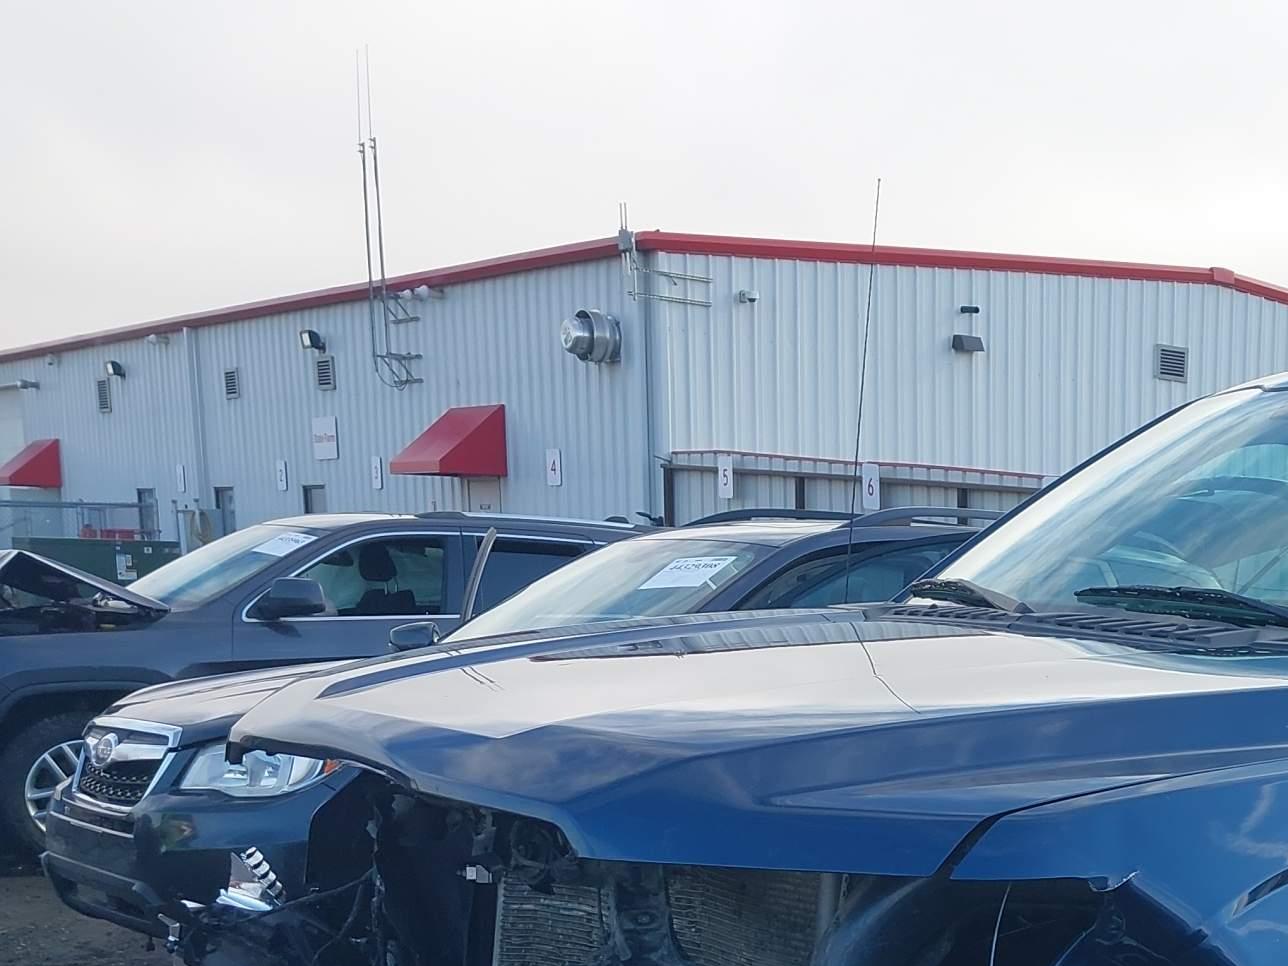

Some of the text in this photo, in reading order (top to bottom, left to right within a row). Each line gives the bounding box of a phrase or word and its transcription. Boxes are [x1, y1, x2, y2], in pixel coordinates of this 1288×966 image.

[550, 459, 557, 476] 4
[722, 468, 729, 486] 5
[867, 477, 874, 496] 6
